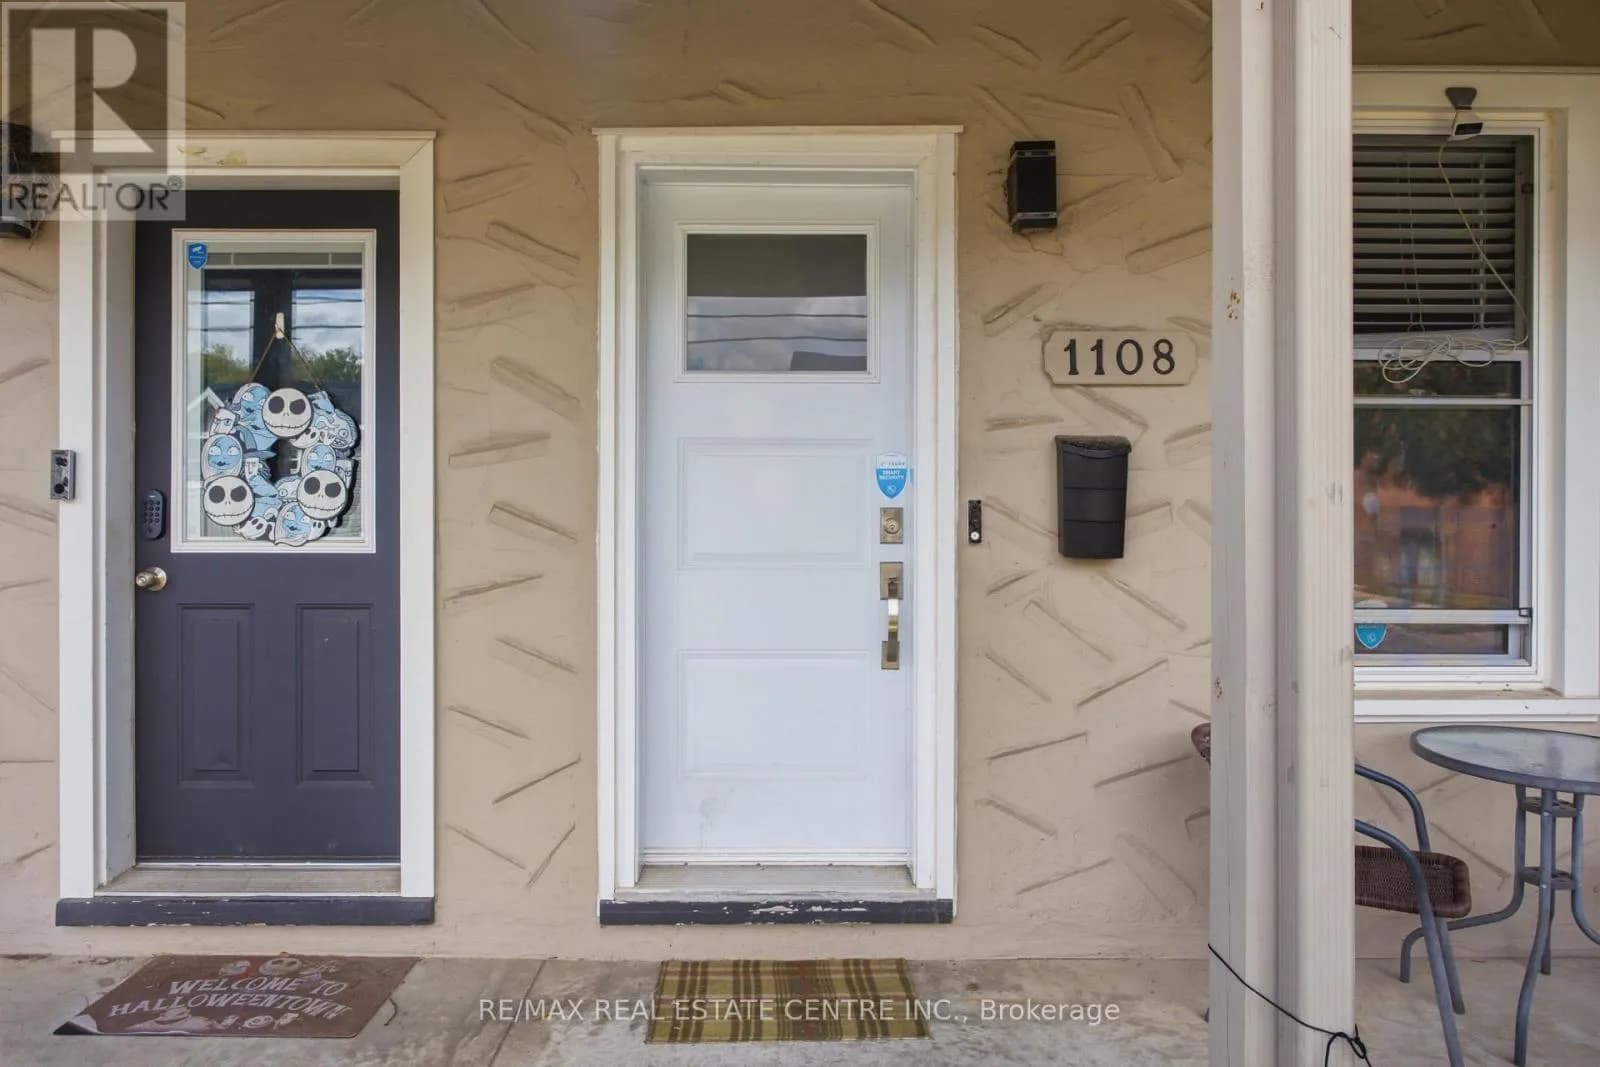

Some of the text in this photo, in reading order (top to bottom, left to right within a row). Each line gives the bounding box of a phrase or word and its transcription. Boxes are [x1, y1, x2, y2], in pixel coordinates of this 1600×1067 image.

[1064, 338, 1175, 375] 1108
[169, 977, 347, 996] WELCOME TO
[109, 993, 352, 1019] HALLOWEENTOWN
